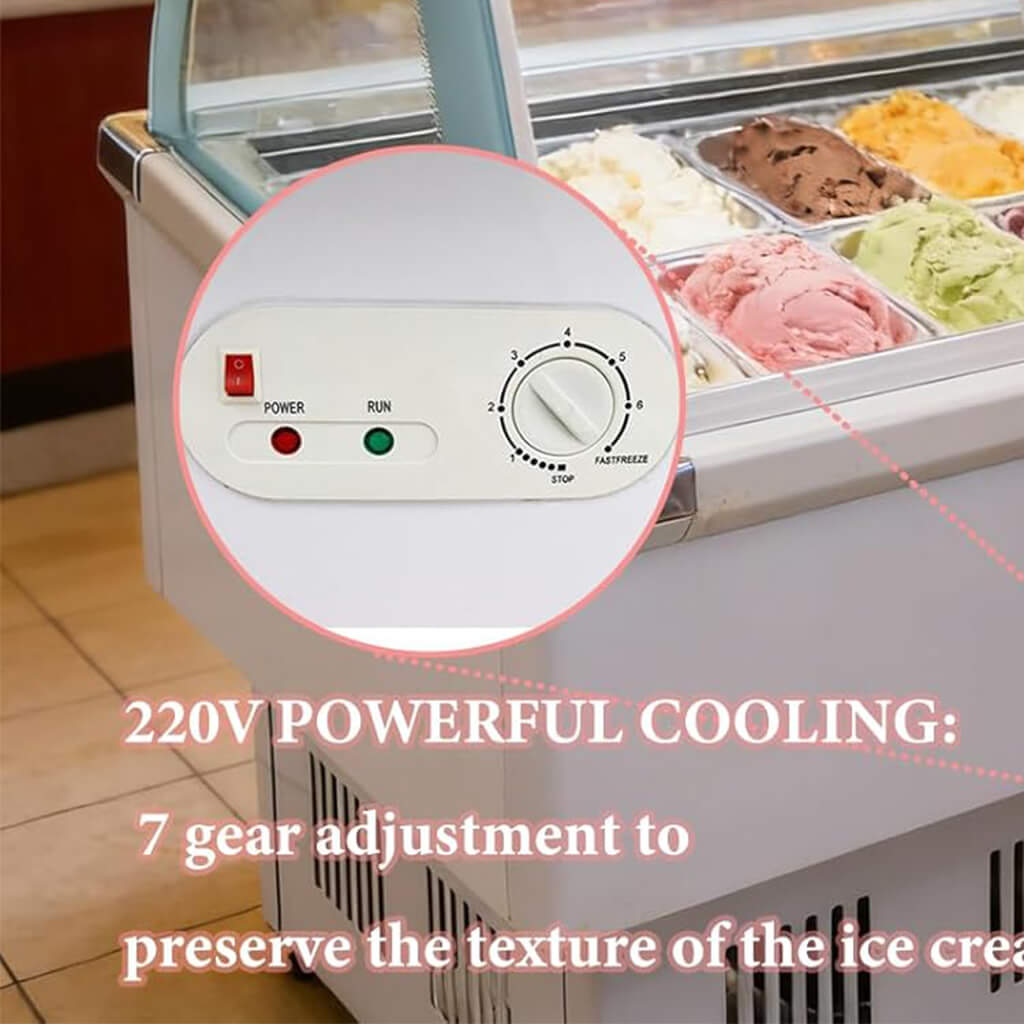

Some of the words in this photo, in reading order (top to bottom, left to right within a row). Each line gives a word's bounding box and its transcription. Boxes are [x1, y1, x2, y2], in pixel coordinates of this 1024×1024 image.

[563, 327, 572, 337] 4
[511, 350, 519, 361] 3
[618, 351, 627, 363] 5
[263, 400, 305, 415] POWER
[367, 400, 392, 414] RUN
[487, 401, 496, 412] 2
[635, 399, 644, 410] 6
[594, 454, 649, 465] FASTFREEZE
[551, 474, 575, 484] STOP
